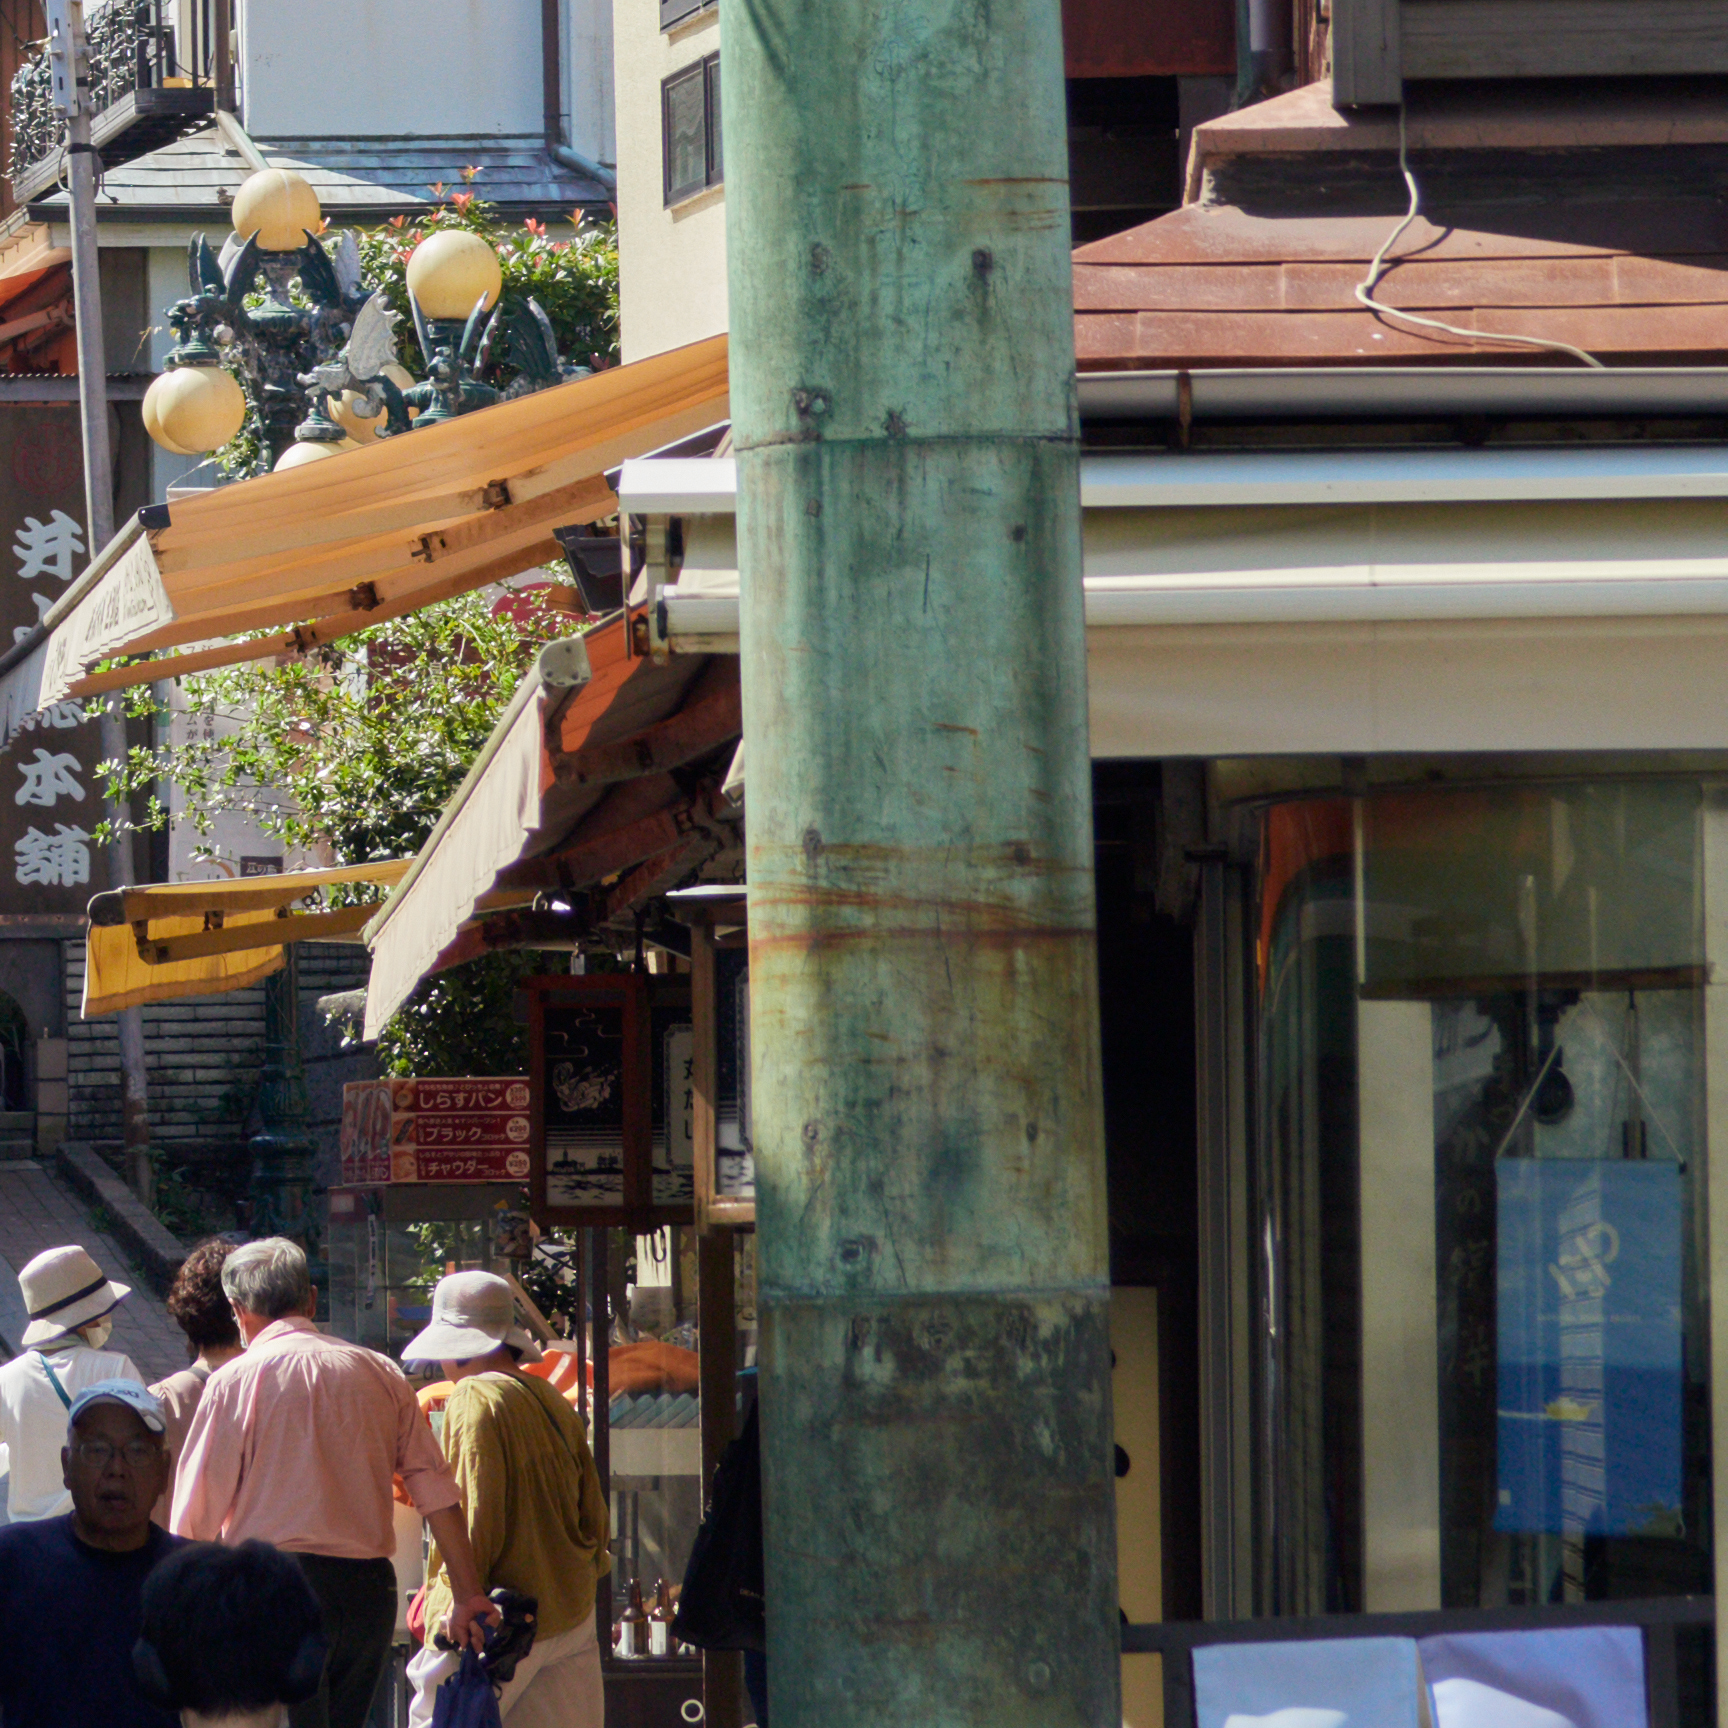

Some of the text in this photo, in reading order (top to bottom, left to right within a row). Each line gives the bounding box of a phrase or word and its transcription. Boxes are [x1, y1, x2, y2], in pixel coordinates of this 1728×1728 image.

[12, 510, 91, 887] 井本舗
[419, 1091, 503, 1109] しらすパン
